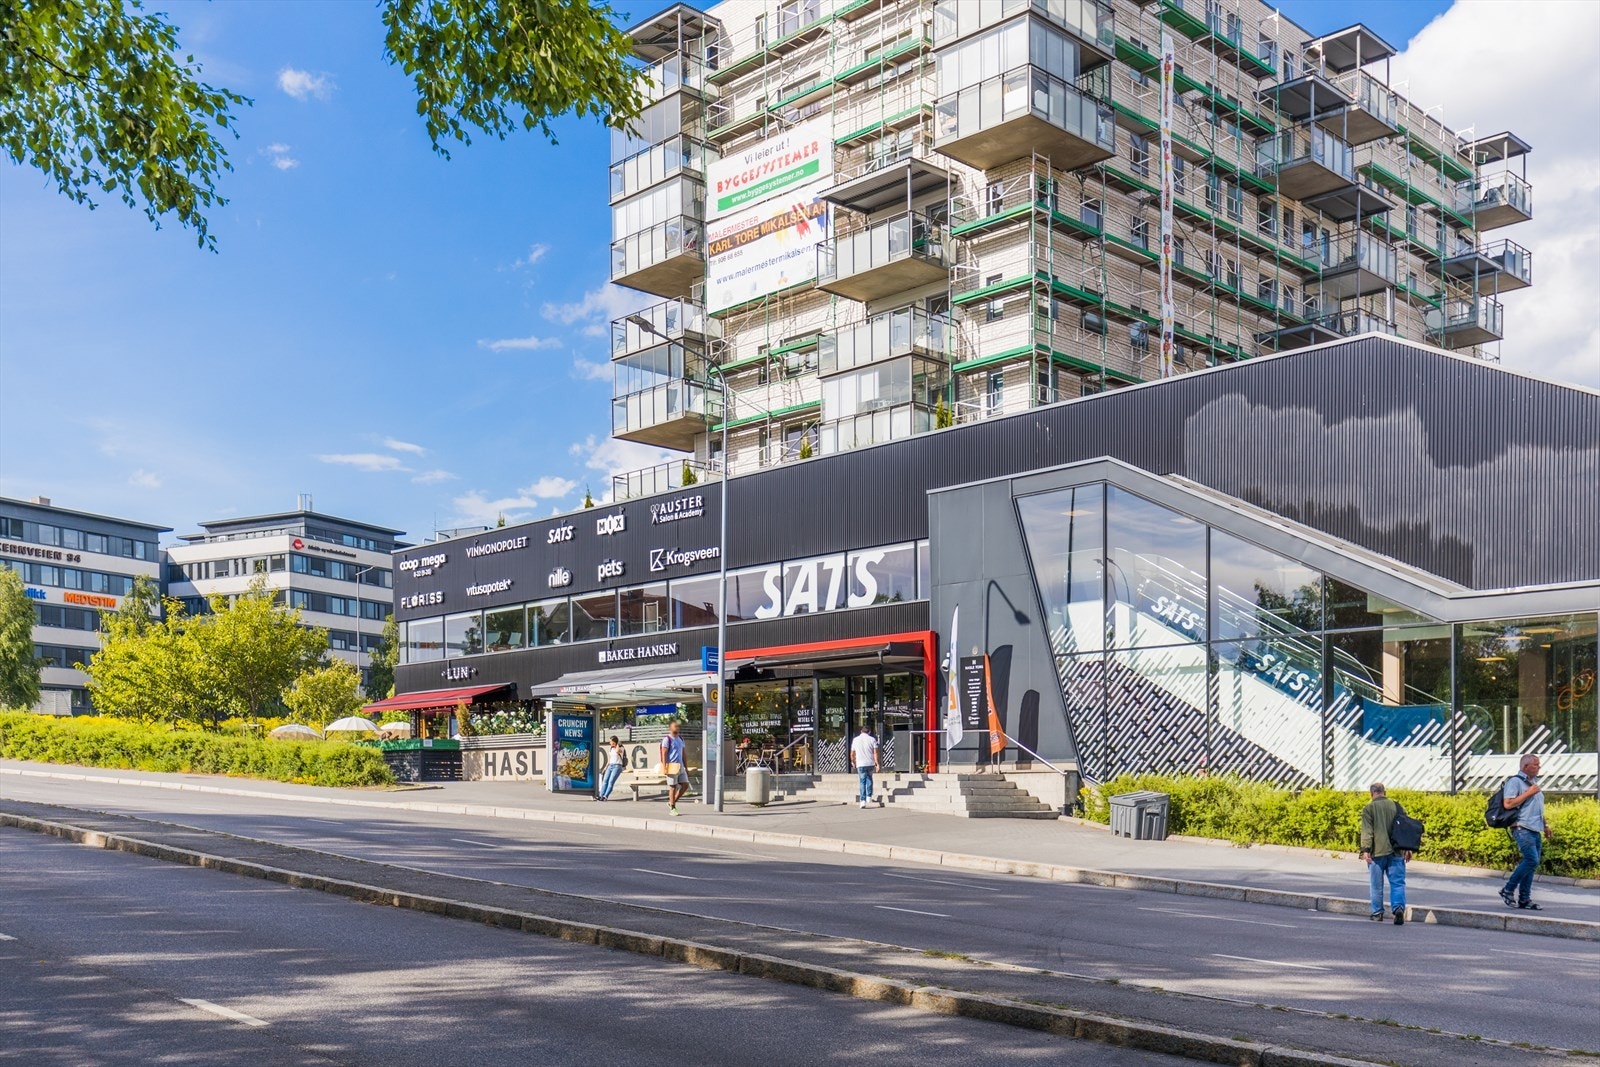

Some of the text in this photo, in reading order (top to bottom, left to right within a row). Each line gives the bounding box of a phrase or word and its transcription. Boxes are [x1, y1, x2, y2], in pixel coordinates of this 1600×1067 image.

[744, 153, 753, 165] Vi
[754, 146, 774, 162] leier
[776, 141, 785, 152] ut
[716, 140, 819, 193] BYGGESYSTEMER
[731, 169, 804, 204] www.byggesystemer.no
[708, 215, 759, 240] MALERMESTER
[709, 238, 733, 256] KARL
[735, 226, 760, 244] TORE
[761, 206, 811, 235] MIKALSEN
[659, 495, 703, 514] AUSTER
[597, 515, 625, 535] MIX
[659, 514, 674, 523] Salon
[679, 508, 703, 520] Academy
[547, 525, 574, 544] SATS
[0, 542, 81, 563] ERNVEIEN 94
[466, 536, 527, 558] VINMONOPOLET
[666, 546, 720, 566] Krogsveen
[399, 553, 446, 571] coop mega
[598, 560, 623, 582] pets
[548, 568, 569, 587] nille
[754, 551, 885, 620] SATS
[401, 591, 443, 609] FLORISS
[1151, 596, 1199, 630] SATS
[606, 642, 677, 663] BAKER HANSEN
[447, 667, 468, 680] LUN
[1255, 653, 1310, 691] SATS
[558, 718, 588, 728] CRUNCHY
[564, 729, 583, 738] NEWS!
[484, 750, 543, 777] HASL
